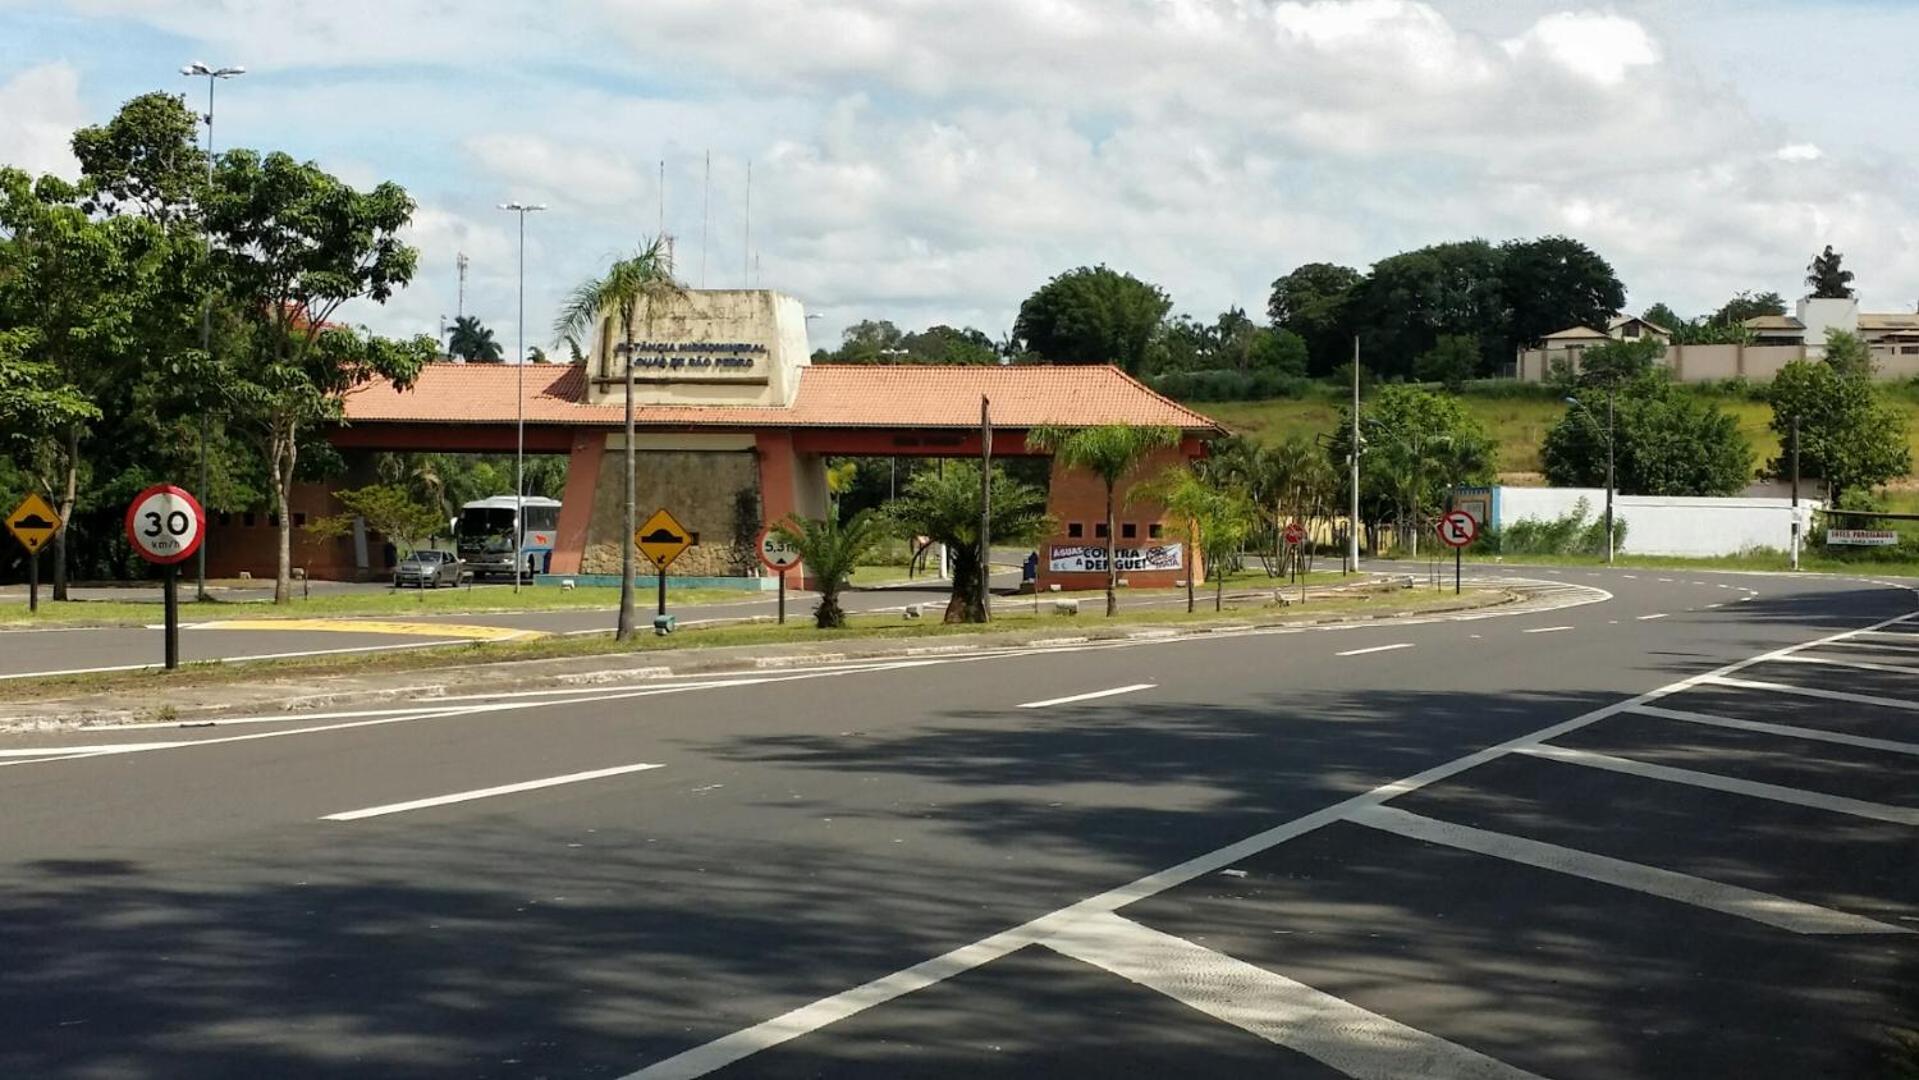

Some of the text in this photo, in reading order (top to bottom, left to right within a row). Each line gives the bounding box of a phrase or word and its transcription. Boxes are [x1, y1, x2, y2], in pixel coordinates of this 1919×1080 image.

[688, 355, 712, 367] SÃO
[715, 358, 754, 367] PEDRO
[144, 510, 189, 537] 30
[151, 540, 180, 549] km/h
[1076, 558, 1083, 566] A
